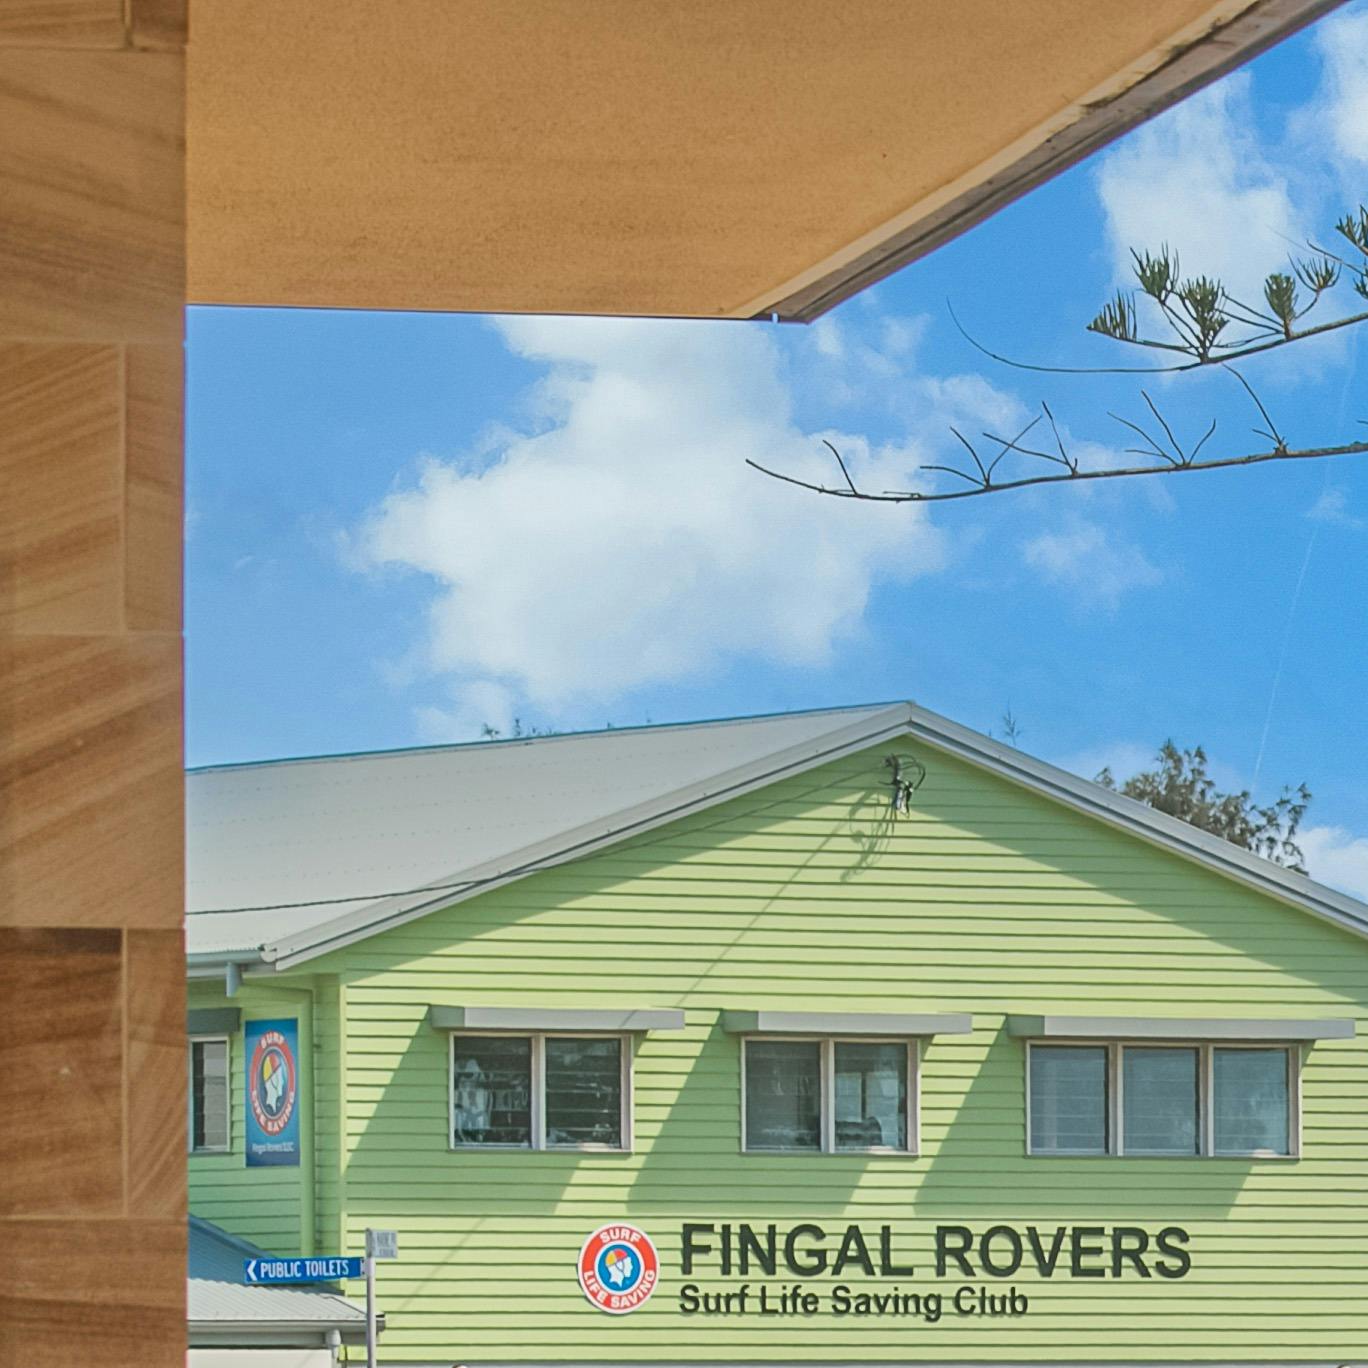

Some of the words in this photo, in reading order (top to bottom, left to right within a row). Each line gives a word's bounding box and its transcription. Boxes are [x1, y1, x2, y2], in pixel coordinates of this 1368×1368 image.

[260, 1032, 285, 1049] SURF
[267, 1091, 295, 1132] SAVING
[599, 1228, 641, 1243] SURF
[680, 1223, 914, 1277] FINGAL
[935, 1226, 1192, 1278] ROVERS
[260, 1261, 302, 1279] PUBLIC
[305, 1259, 349, 1277] TOILETS
[583, 1270, 608, 1304] LIFE
[610, 1269, 655, 1308] SAVING
[679, 1284, 750, 1318] Surf
[760, 1285, 819, 1318] Life
[832, 1286, 943, 1323] Saving
[953, 1286, 1029, 1318] Club
